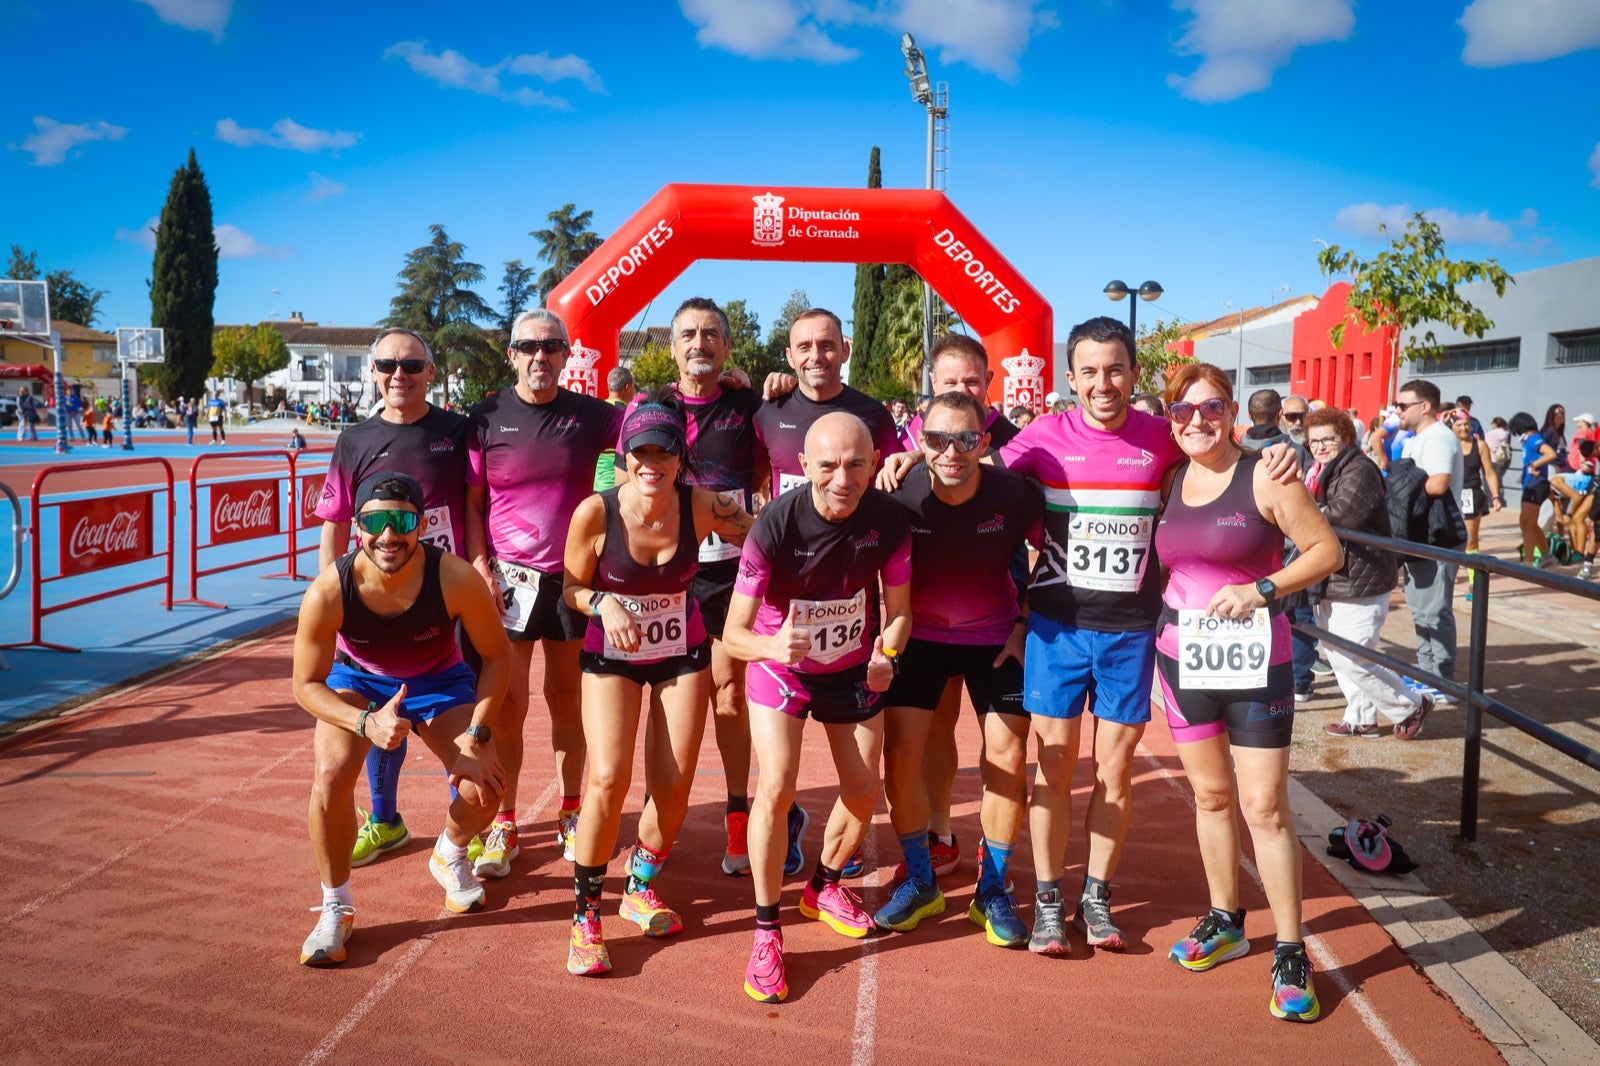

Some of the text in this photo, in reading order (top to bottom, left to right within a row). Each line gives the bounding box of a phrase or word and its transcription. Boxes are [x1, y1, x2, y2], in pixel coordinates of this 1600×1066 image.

[788, 206, 860, 221] Diputación
[788, 225, 860, 239] de Granada
[585, 219, 674, 307] DEPORTES
[934, 228, 1021, 315] DEPORTES
[214, 489, 274, 534] Coca-Cola
[69, 510, 141, 559] Coca-Cola
[977, 526, 996, 534] SANTA
[1088, 522, 1139, 536] FONDO
[1073, 545, 1146, 574] 3137
[622, 598, 670, 613] FONDO
[808, 604, 857, 619] FONDO
[1199, 616, 1253, 630] FONDO
[809, 619, 862, 651] 136
[1185, 642, 1265, 671] 3069
